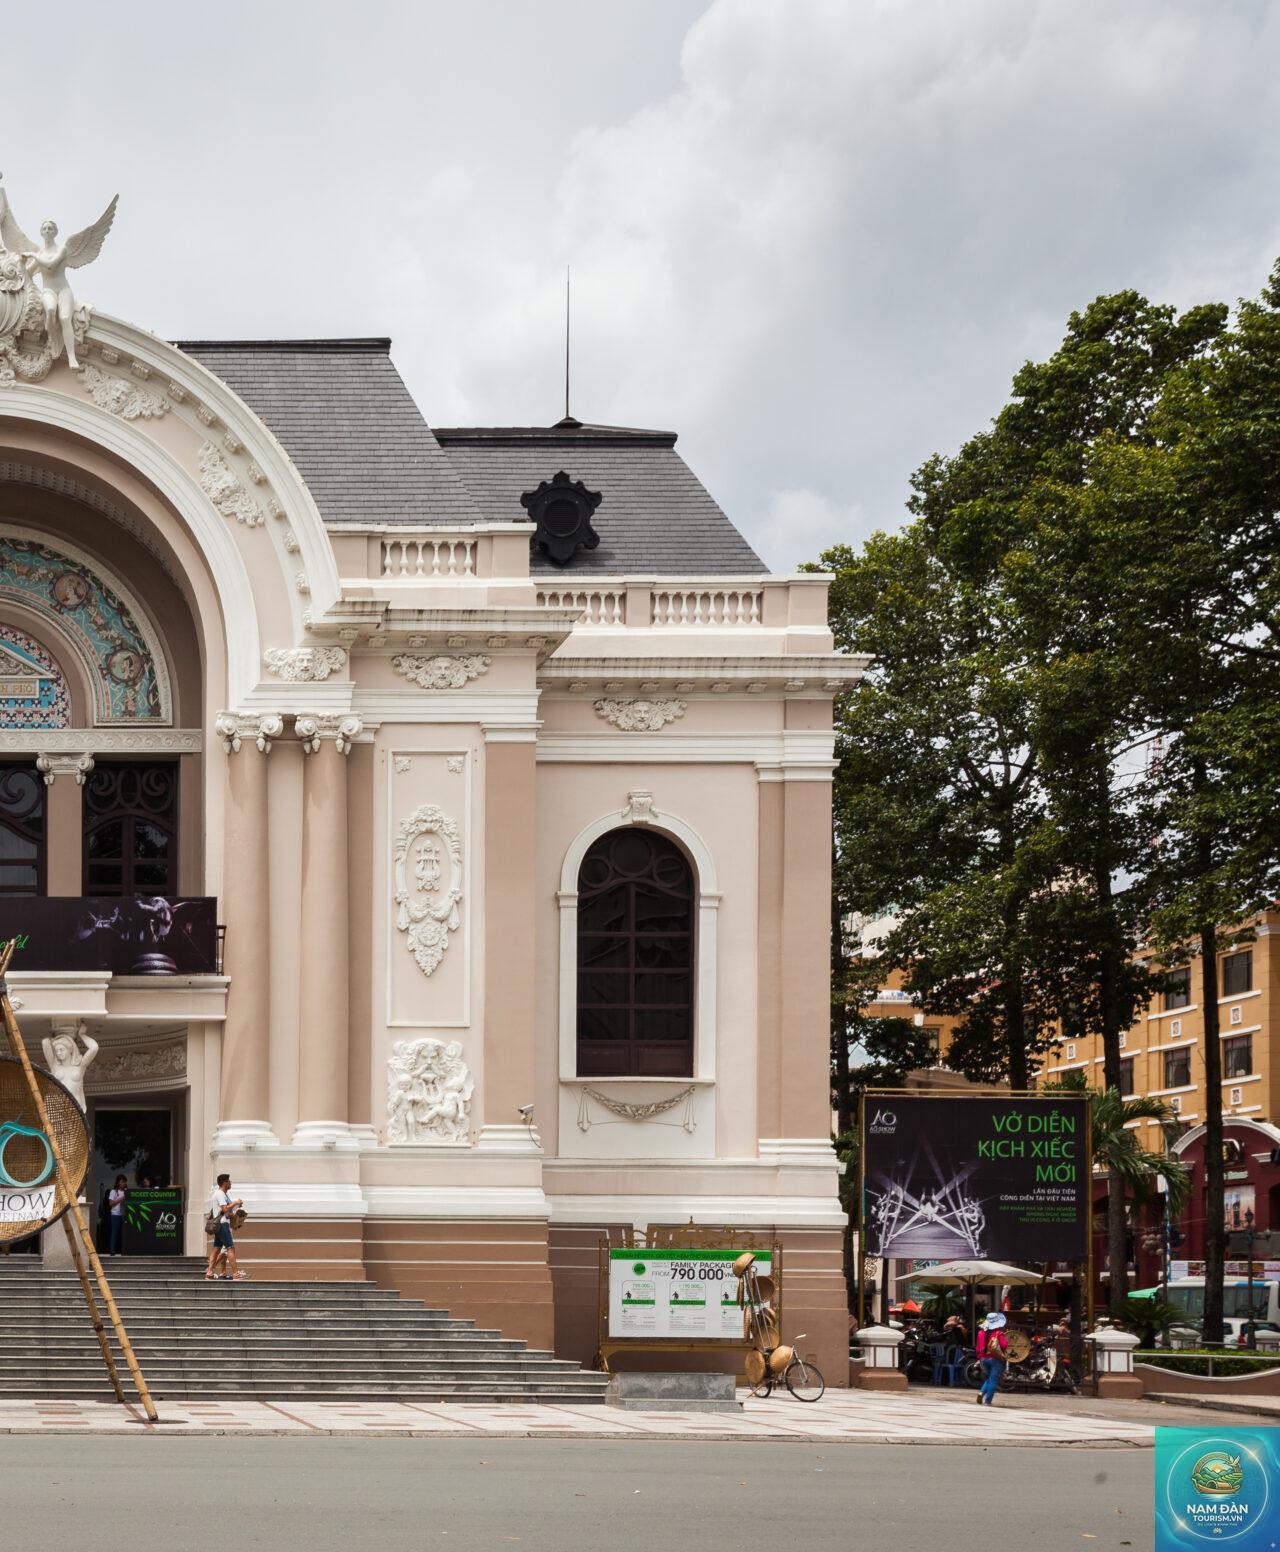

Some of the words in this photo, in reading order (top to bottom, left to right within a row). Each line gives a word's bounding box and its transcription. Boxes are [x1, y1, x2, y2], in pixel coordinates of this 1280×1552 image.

[992, 1110, 1023, 1133] VỞ
[1028, 1110, 1075, 1133] DIỄN
[978, 1140, 1025, 1162] KỊCH
[1031, 1136, 1075, 1158] XIẾC
[1036, 1163, 1076, 1182] MỚI
[651, 1270, 671, 1278] FROM
[670, 1267, 724, 1281] 790.000
[670, 1261, 698, 1269] FAMILY
